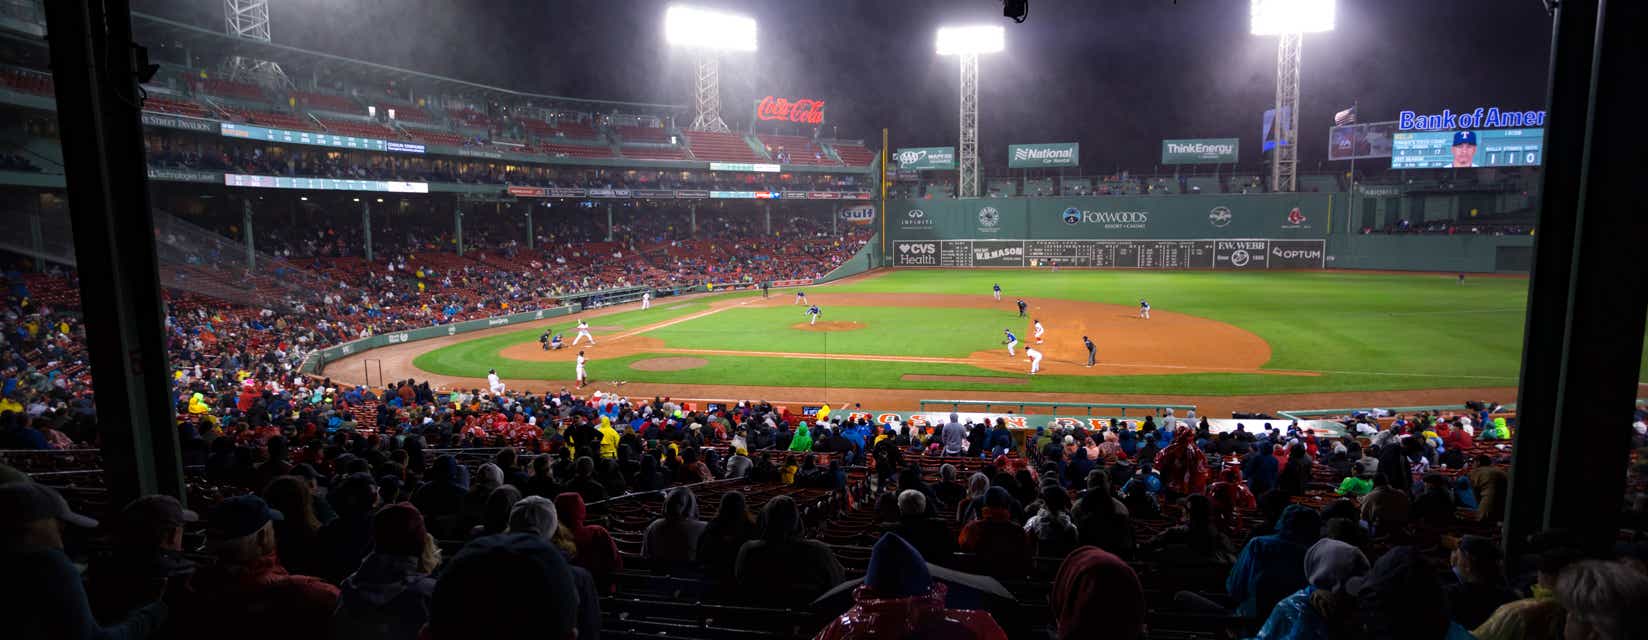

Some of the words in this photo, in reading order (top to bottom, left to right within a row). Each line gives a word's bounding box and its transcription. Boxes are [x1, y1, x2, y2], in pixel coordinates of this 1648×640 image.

[1400, 109, 1456, 131] Bank
[1459, 107, 1484, 129] of
[1485, 106, 1546, 128] Amer
[1028, 147, 1073, 159] National
[1167, 143, 1233, 155] ThinkEnergy
[1491, 153, 1496, 164] 1
[1508, 153, 1514, 163] 1
[1526, 152, 1535, 163] 0
[842, 207, 874, 220] Gulf
[1083, 211, 1149, 223] FOXWOODS
[911, 244, 936, 254] CVS
[1283, 250, 1321, 259] OPTUM
[901, 254, 936, 265] Health
[848, 411, 1028, 429] BOSN
